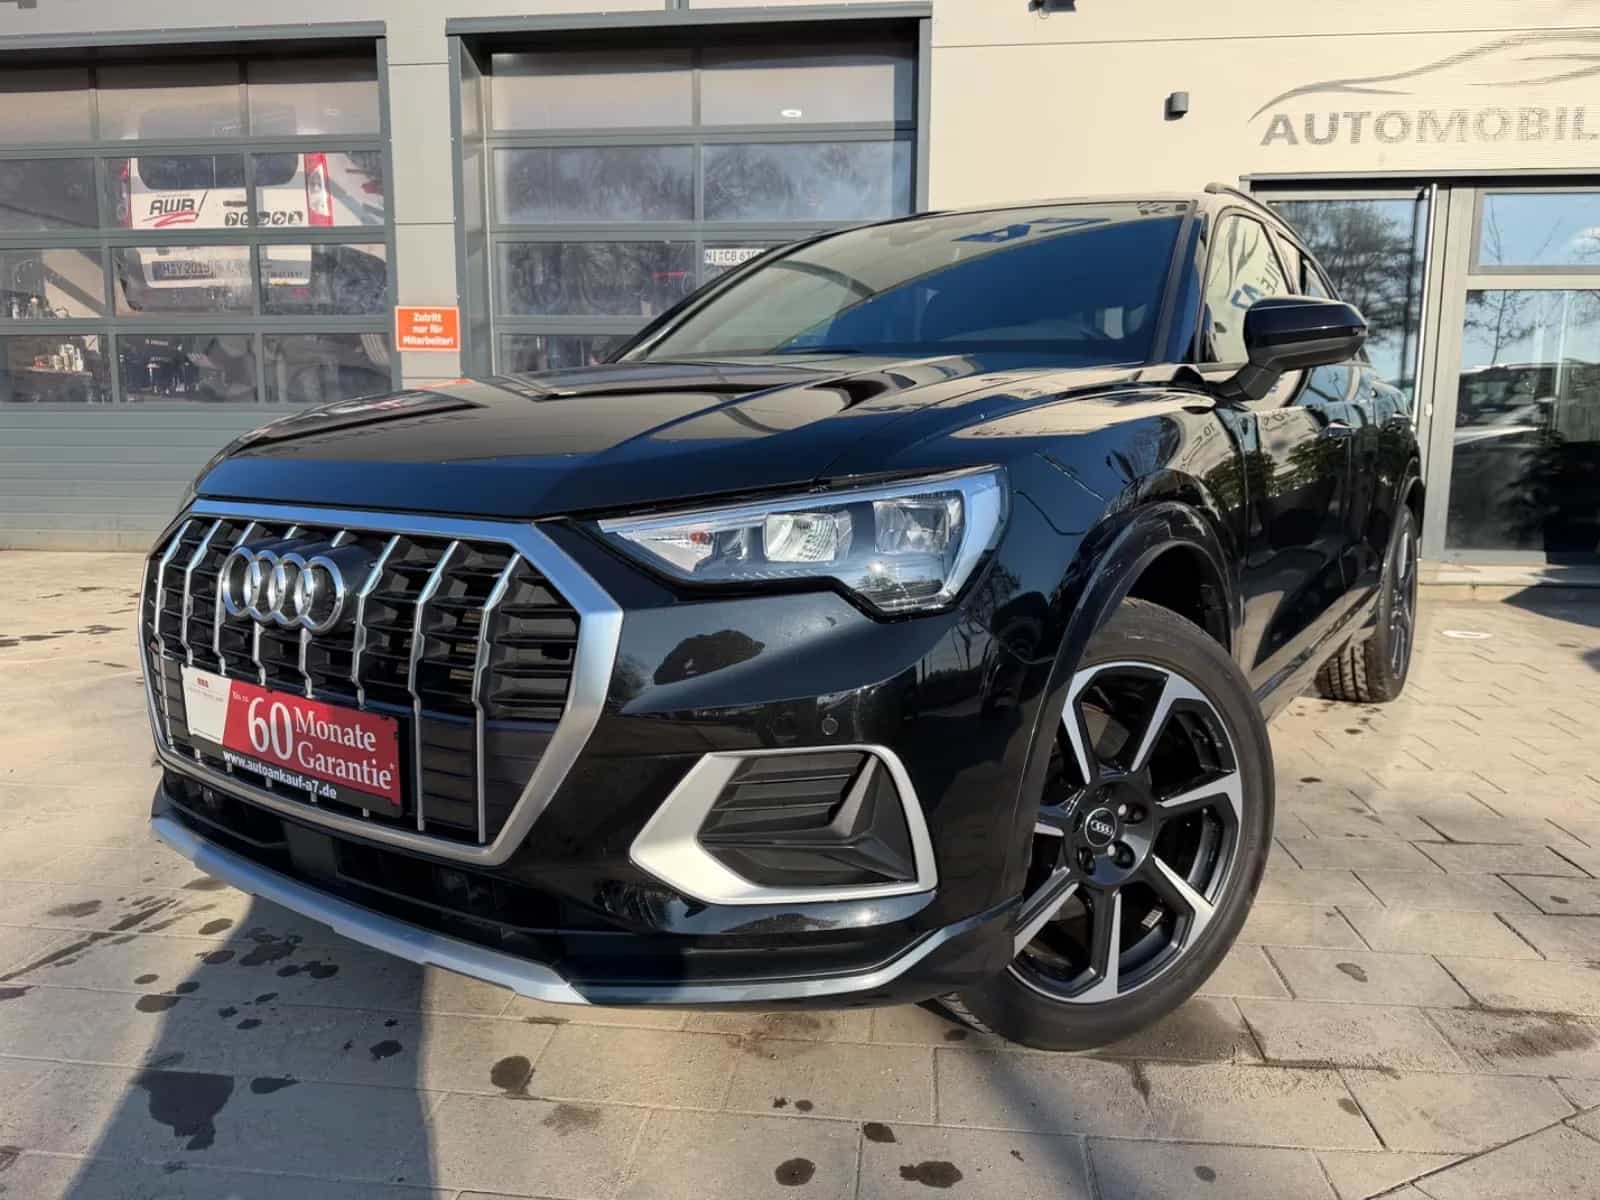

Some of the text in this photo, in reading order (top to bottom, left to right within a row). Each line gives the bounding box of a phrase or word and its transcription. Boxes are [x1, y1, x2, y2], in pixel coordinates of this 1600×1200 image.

[412, 323, 443, 335] nur für
[413, 312, 442, 323] Zutritt
[247, 697, 293, 760] 60
[294, 706, 376, 751] Monate
[223, 750, 337, 799] www.autoankauf-a7.de
